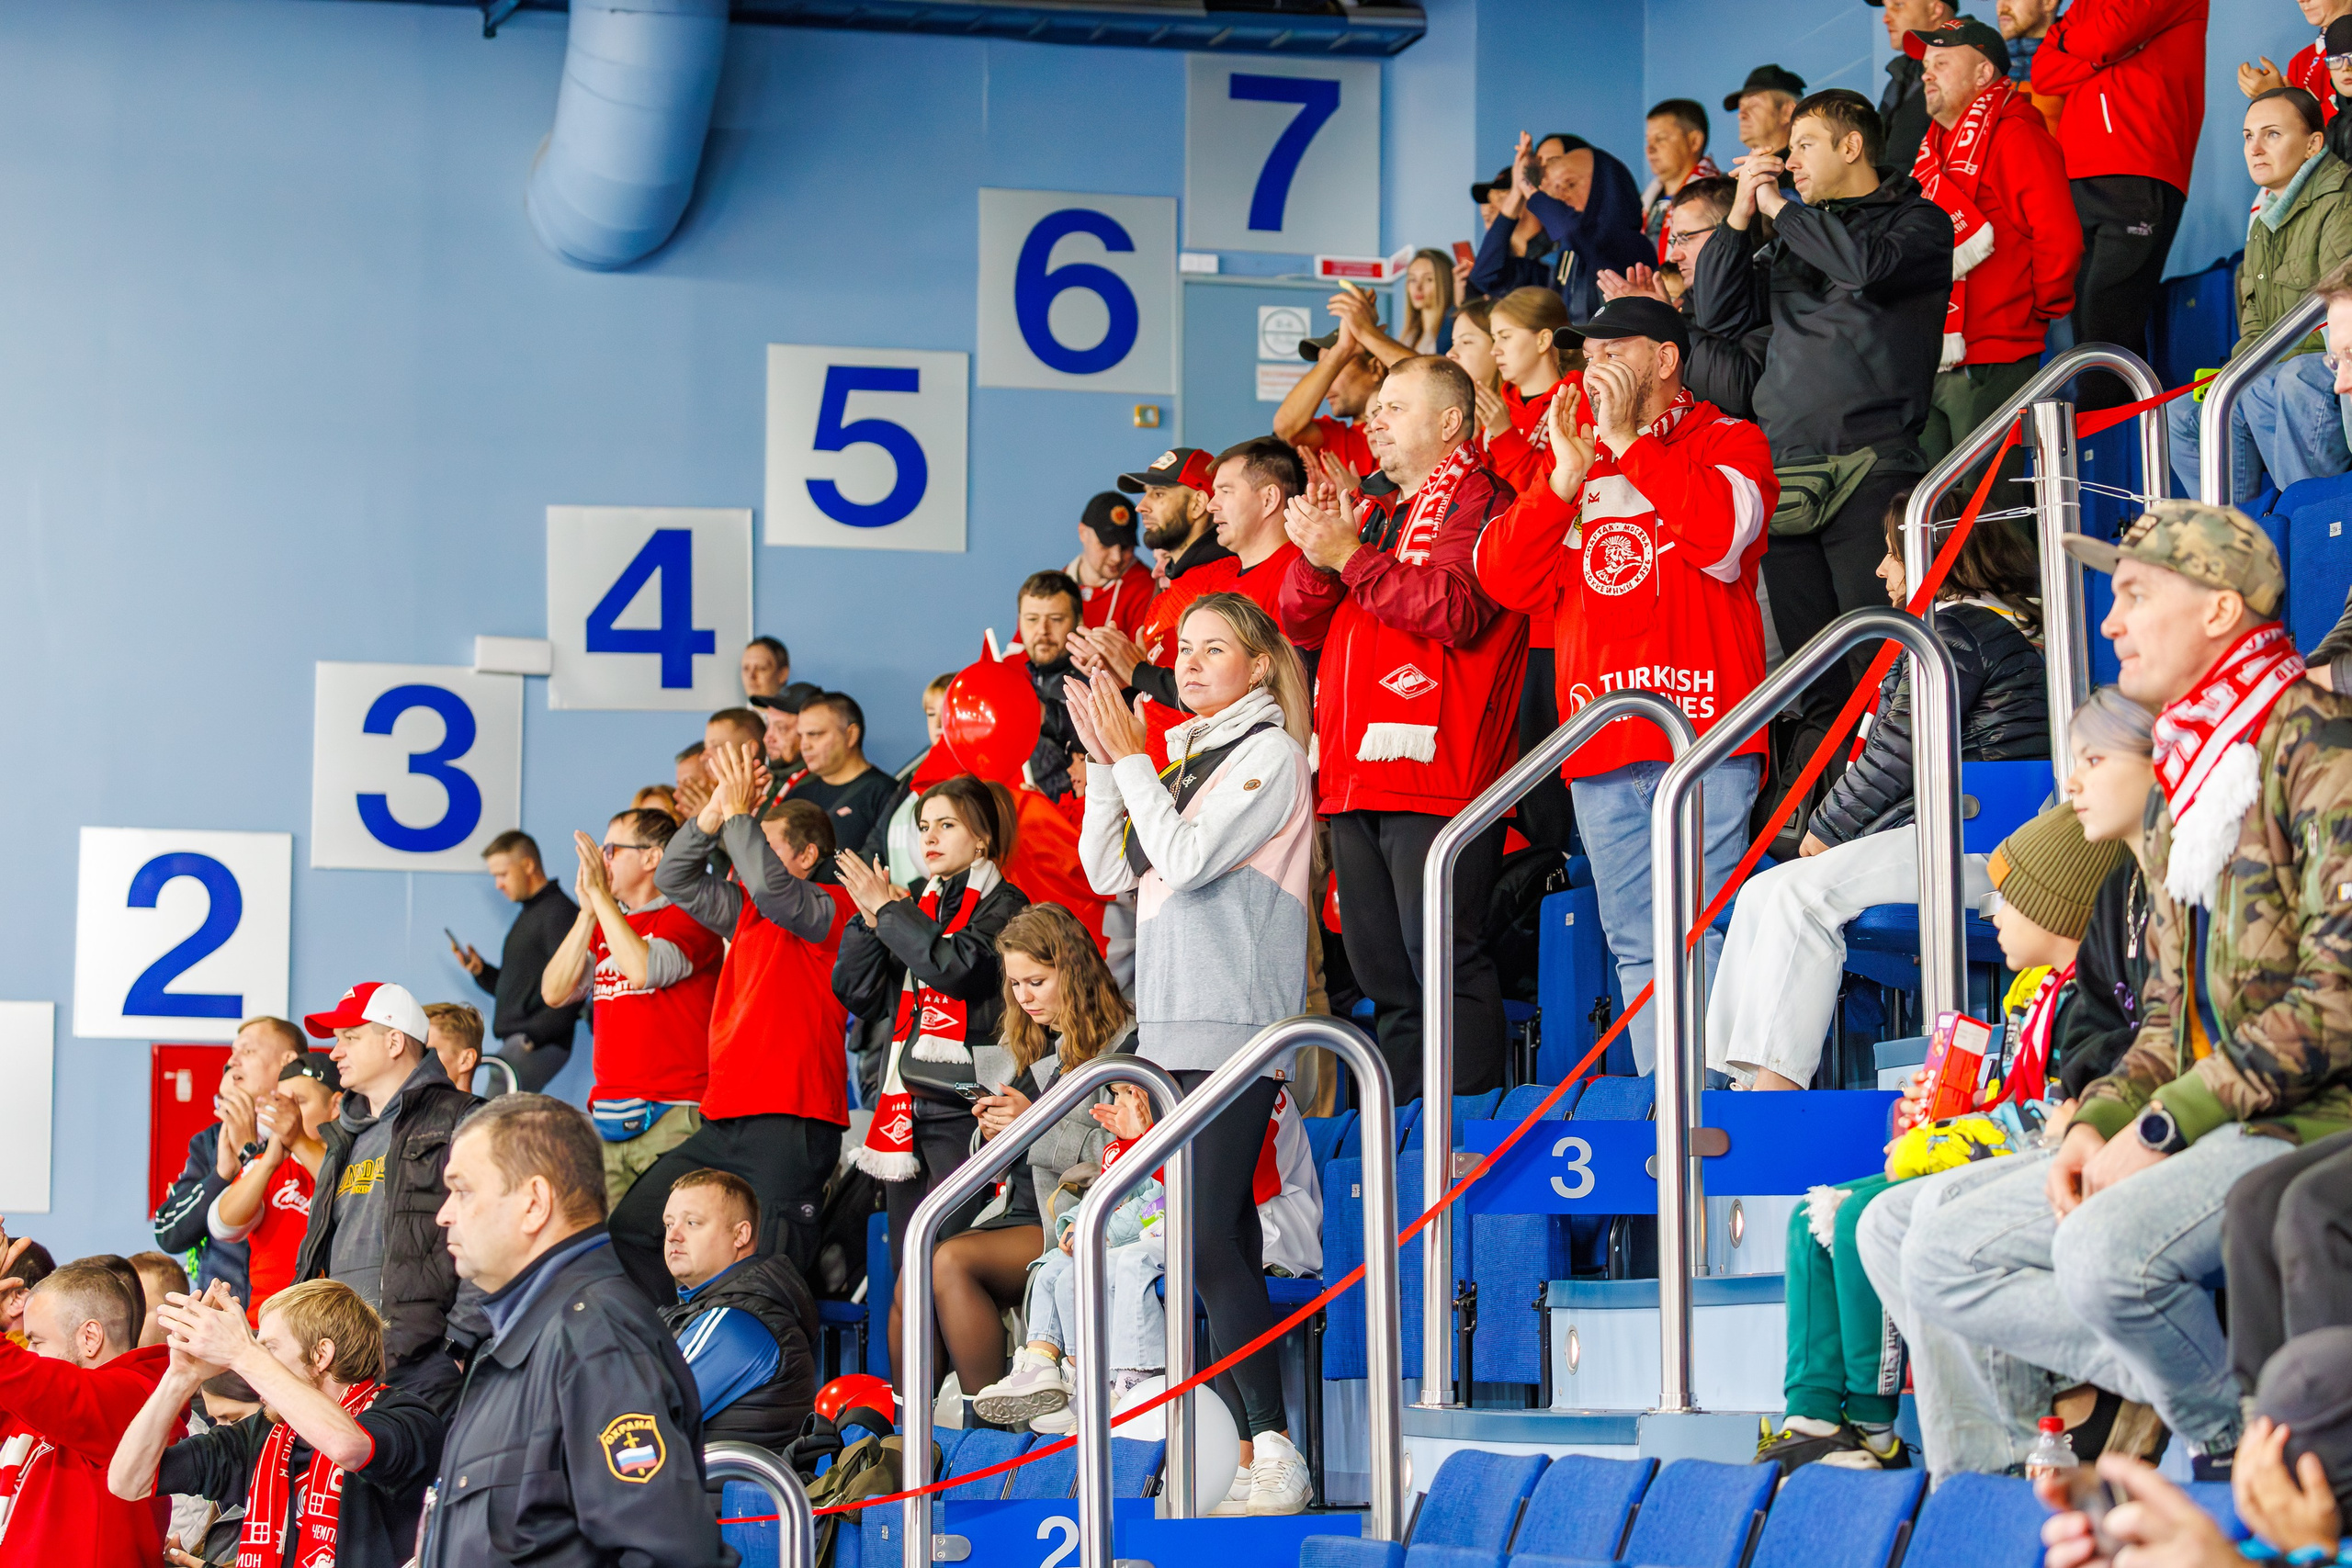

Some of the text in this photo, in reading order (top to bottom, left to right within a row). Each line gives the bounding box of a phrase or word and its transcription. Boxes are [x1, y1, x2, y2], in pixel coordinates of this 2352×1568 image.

[1228, 73, 1341, 232] 7
[1014, 208, 1139, 375] 6
[806, 366, 928, 529] 5
[585, 529, 716, 690] 4
[1600, 665, 1713, 694] TURKISH
[356, 684, 482, 853] 3
[122, 853, 243, 1019] 2
[1550, 1136, 1595, 1199] 3
[605, 1419, 652, 1446] ОХРАНА
[311, 1523, 337, 1545] ЧЕМП
[1036, 1515, 1080, 1568] 2
